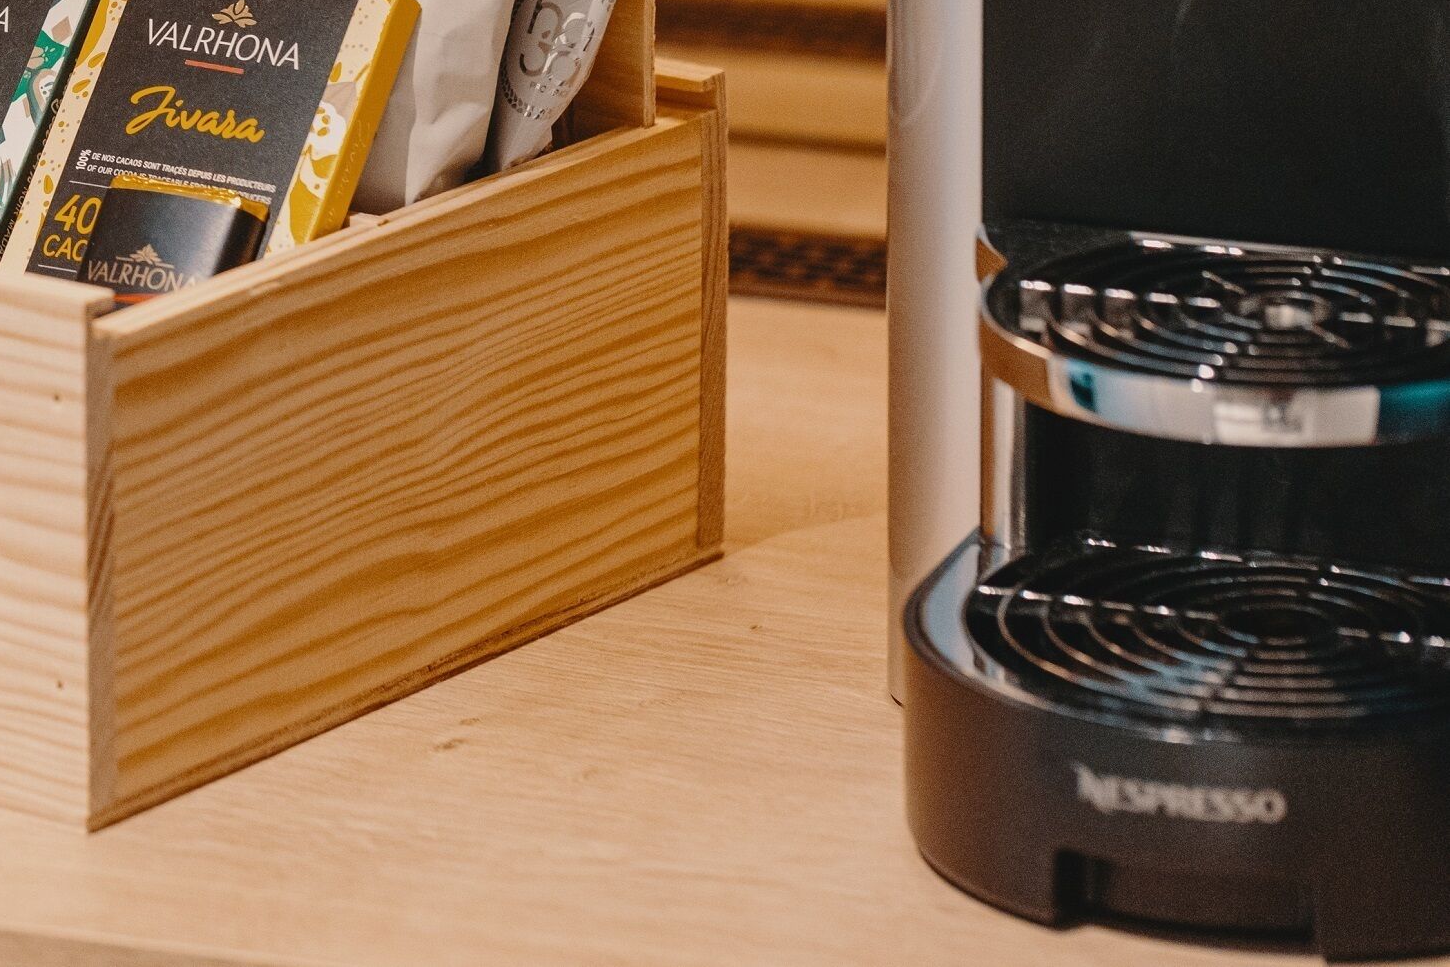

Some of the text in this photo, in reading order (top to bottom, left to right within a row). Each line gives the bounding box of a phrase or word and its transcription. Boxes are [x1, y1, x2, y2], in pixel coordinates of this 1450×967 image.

[147, 18, 300, 70] VALRHONA
[125, 85, 266, 143] Jivara
[75, 149, 92, 170] 100%
[86, 164, 98, 172] OF
[97, 165, 114, 175] OUR
[91, 152, 102, 161] DE
[101, 153, 116, 163] NOS
[115, 156, 143, 168] CACAOS
[142, 160, 162, 171] SONT
[187, 168, 213, 181] DEPUIS
[212, 172, 227, 183] LES
[226, 176, 277, 194] PRODUCTEURS
[54, 194, 102, 234] 40
[42, 234, 89, 263] CAC
